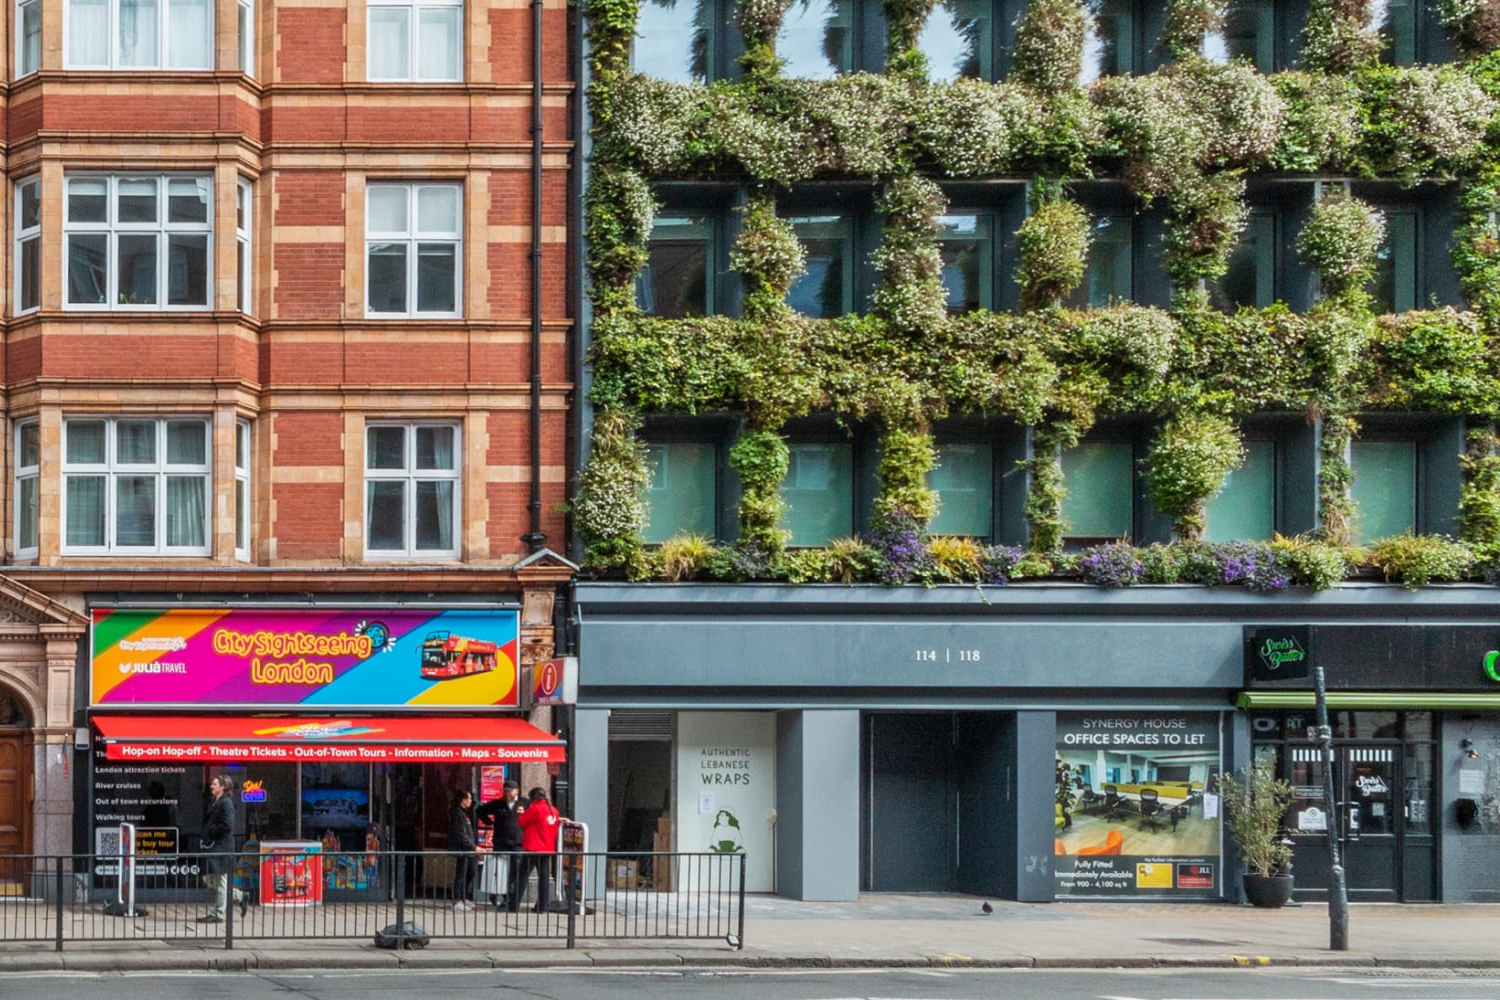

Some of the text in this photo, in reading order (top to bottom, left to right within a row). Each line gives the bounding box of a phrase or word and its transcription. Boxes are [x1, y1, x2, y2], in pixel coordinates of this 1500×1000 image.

[214, 629, 372, 658] City Sightseeing
[1261, 638, 1294, 656] Swiss
[916, 650, 936, 661] 114
[959, 650, 980, 661] 118
[1270, 650, 1304, 669] Butter
[161, 663, 187, 673] TRAVEL
[252, 658, 333, 683] London
[1083, 718, 1186, 729] SYNERGY HOUSE
[1064, 733, 1205, 745] OFFICE SPACES TO LET
[123, 746, 160, 757] Hop-on
[163, 746, 202, 757] Hop-off
[209, 746, 248, 756] Theatre
[251, 746, 287, 756] Tickets
[294, 747, 356, 757] Out-of-Town
[358, 748, 386, 757] Tours
[395, 748, 453, 757] Information
[462, 748, 489, 759] Maps
[498, 748, 548, 758] Souvenirs
[701, 761, 750, 769] LEBANESE
[701, 773, 750, 785] WRAPS
[95, 814, 125, 822] Walking
[143, 840, 157, 848] buy
[1075, 860, 1113, 869] Fully Fitted
[1054, 870, 1099, 879] Immediately
[1100, 870, 1133, 878] Available
